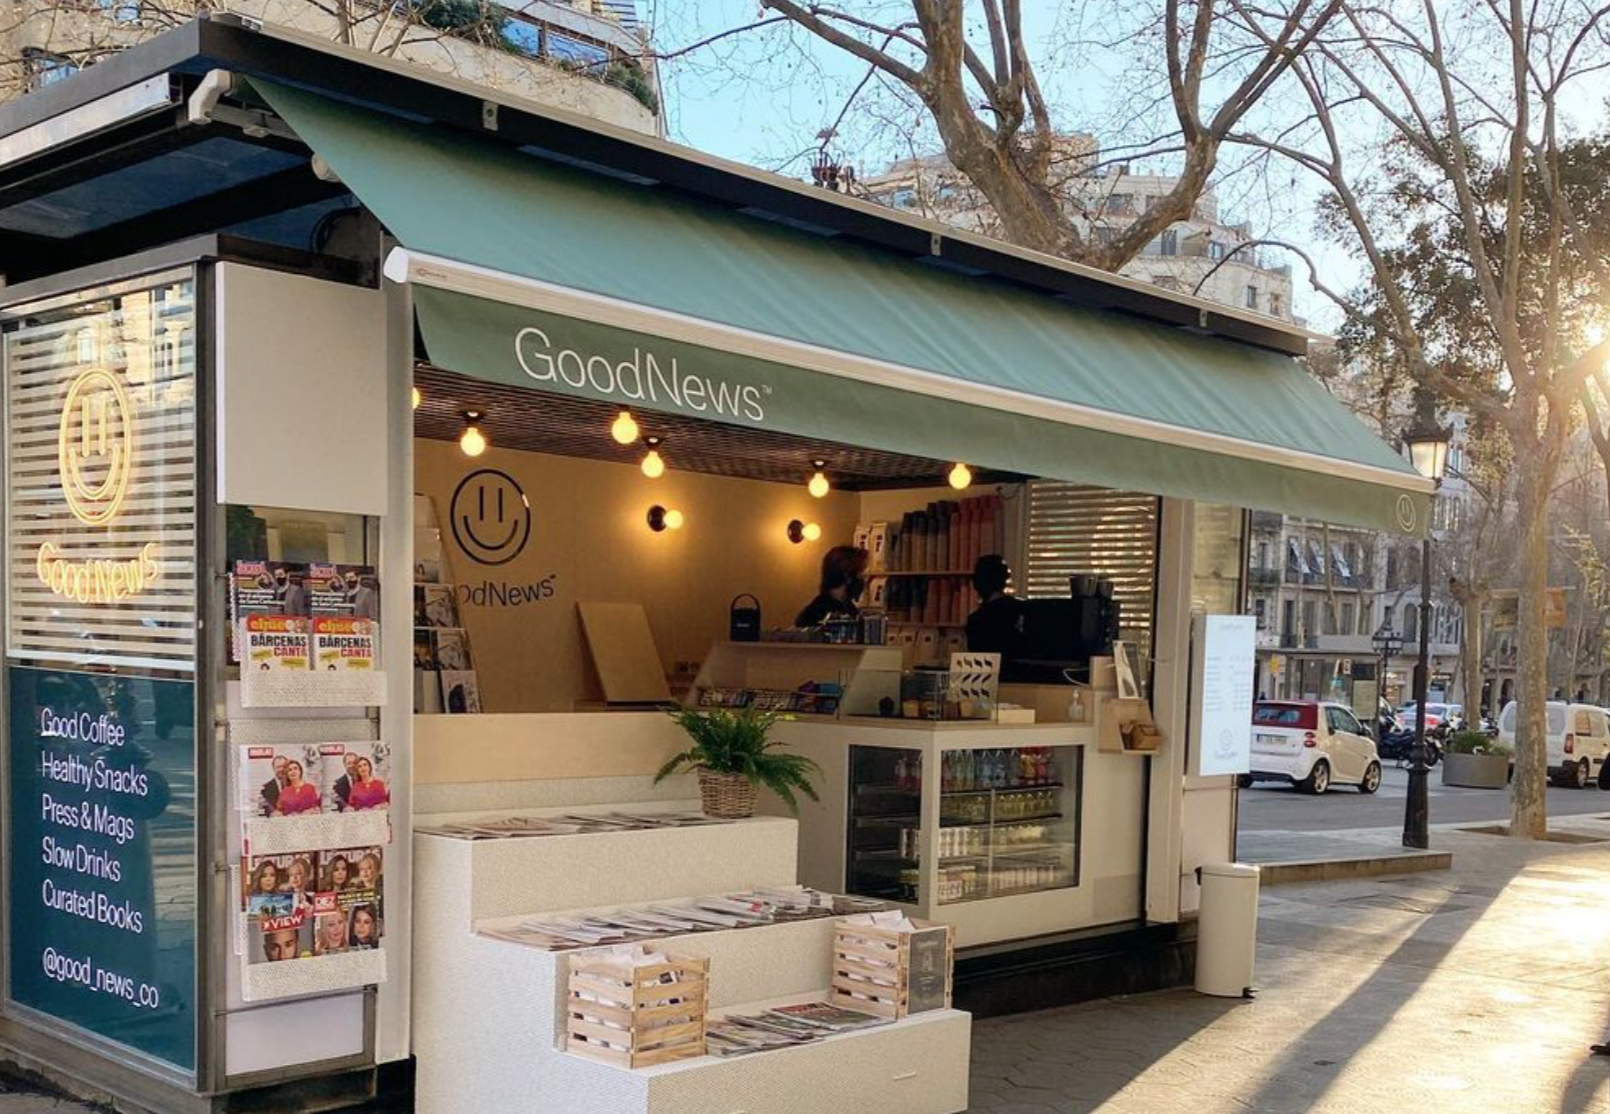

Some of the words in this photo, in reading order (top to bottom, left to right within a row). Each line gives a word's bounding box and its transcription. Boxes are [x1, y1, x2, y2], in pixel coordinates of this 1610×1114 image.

[250, 633, 307, 647] BÁRCENAS
[318, 635, 372, 649] BÁRCENAS
[41, 707, 78, 740] Good
[80, 712, 125, 747] Coffee
[42, 750, 93, 792] Healthy
[95, 759, 148, 797] Snacks
[42, 793, 79, 828] Press
[80, 801, 92, 831] &
[94, 804, 135, 845] Mags
[42, 836, 75, 870] Slow
[76, 844, 121, 882] Drinks
[42, 878, 95, 920] Curated
[97, 893, 143, 934] Books
[43, 946, 160, 1009] @good_news_co
